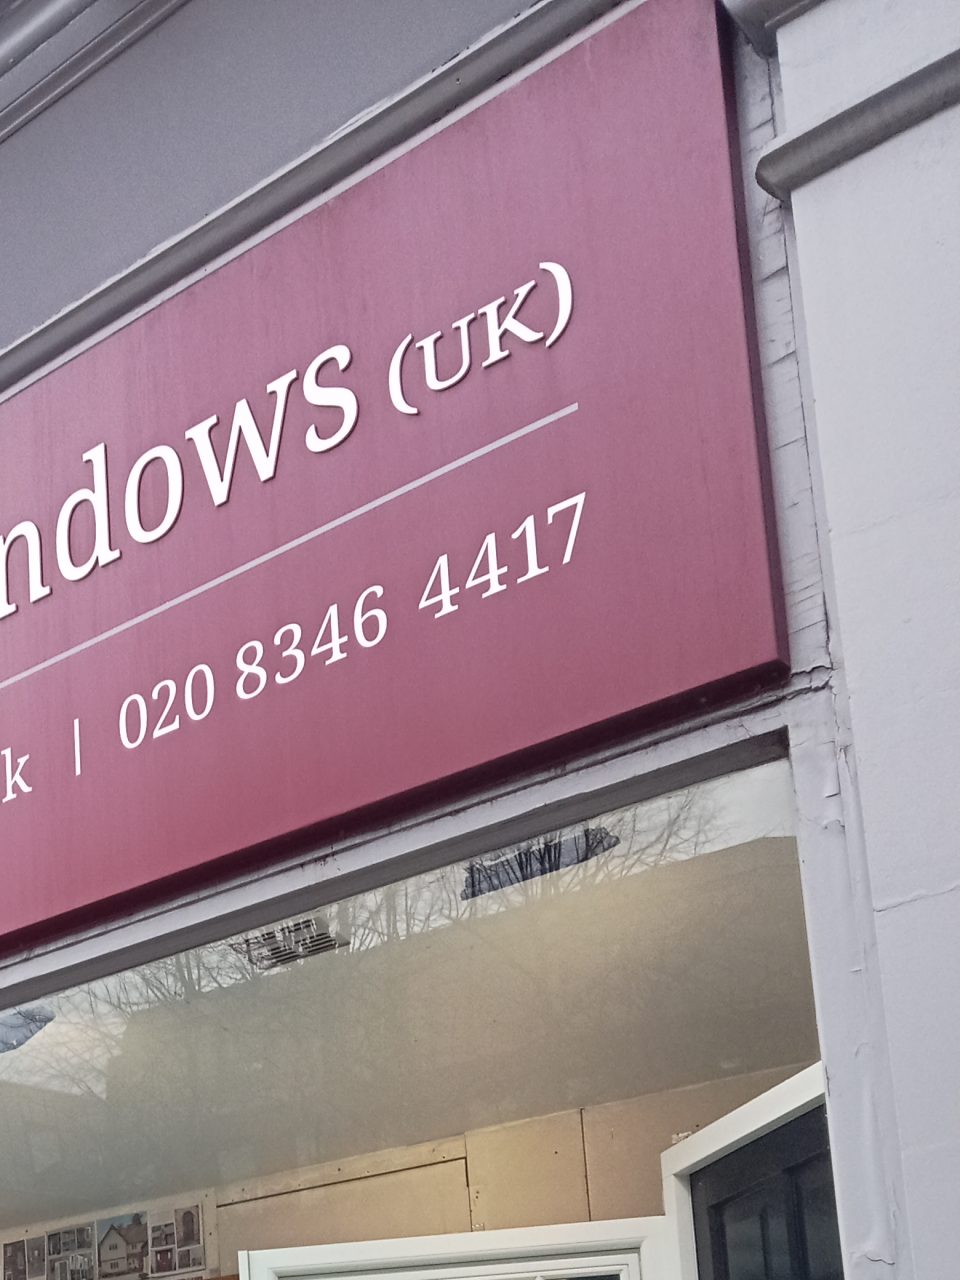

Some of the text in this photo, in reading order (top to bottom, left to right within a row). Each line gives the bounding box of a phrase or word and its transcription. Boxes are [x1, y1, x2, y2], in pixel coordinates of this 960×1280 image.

[387, 261, 575, 415] (UK)
[117, 663, 215, 750] 020
[234, 584, 389, 701] 8346
[417, 491, 587, 621] 4417
